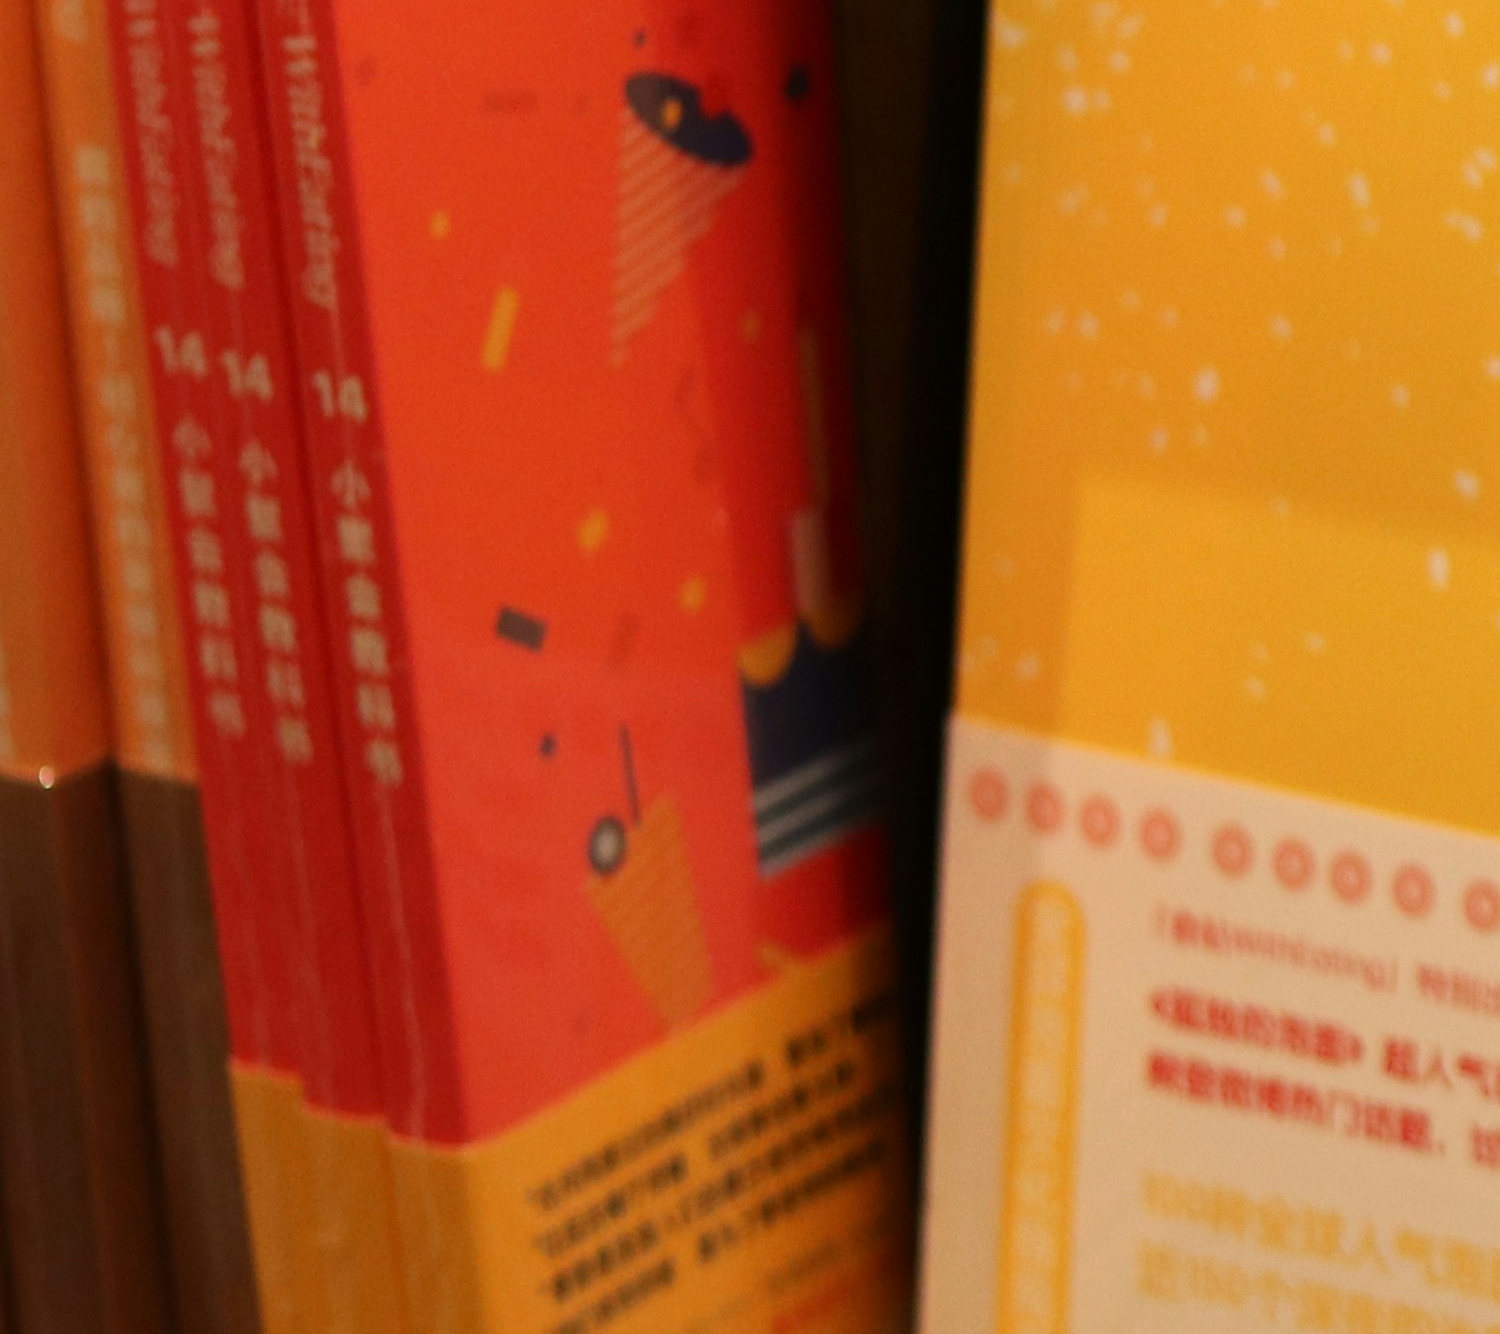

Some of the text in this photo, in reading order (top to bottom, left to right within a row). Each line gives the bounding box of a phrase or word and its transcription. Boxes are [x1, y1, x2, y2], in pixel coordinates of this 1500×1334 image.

[155, 326, 209, 380] 14
[220, 348, 274, 403] 14
[312, 370, 368, 424] 14
